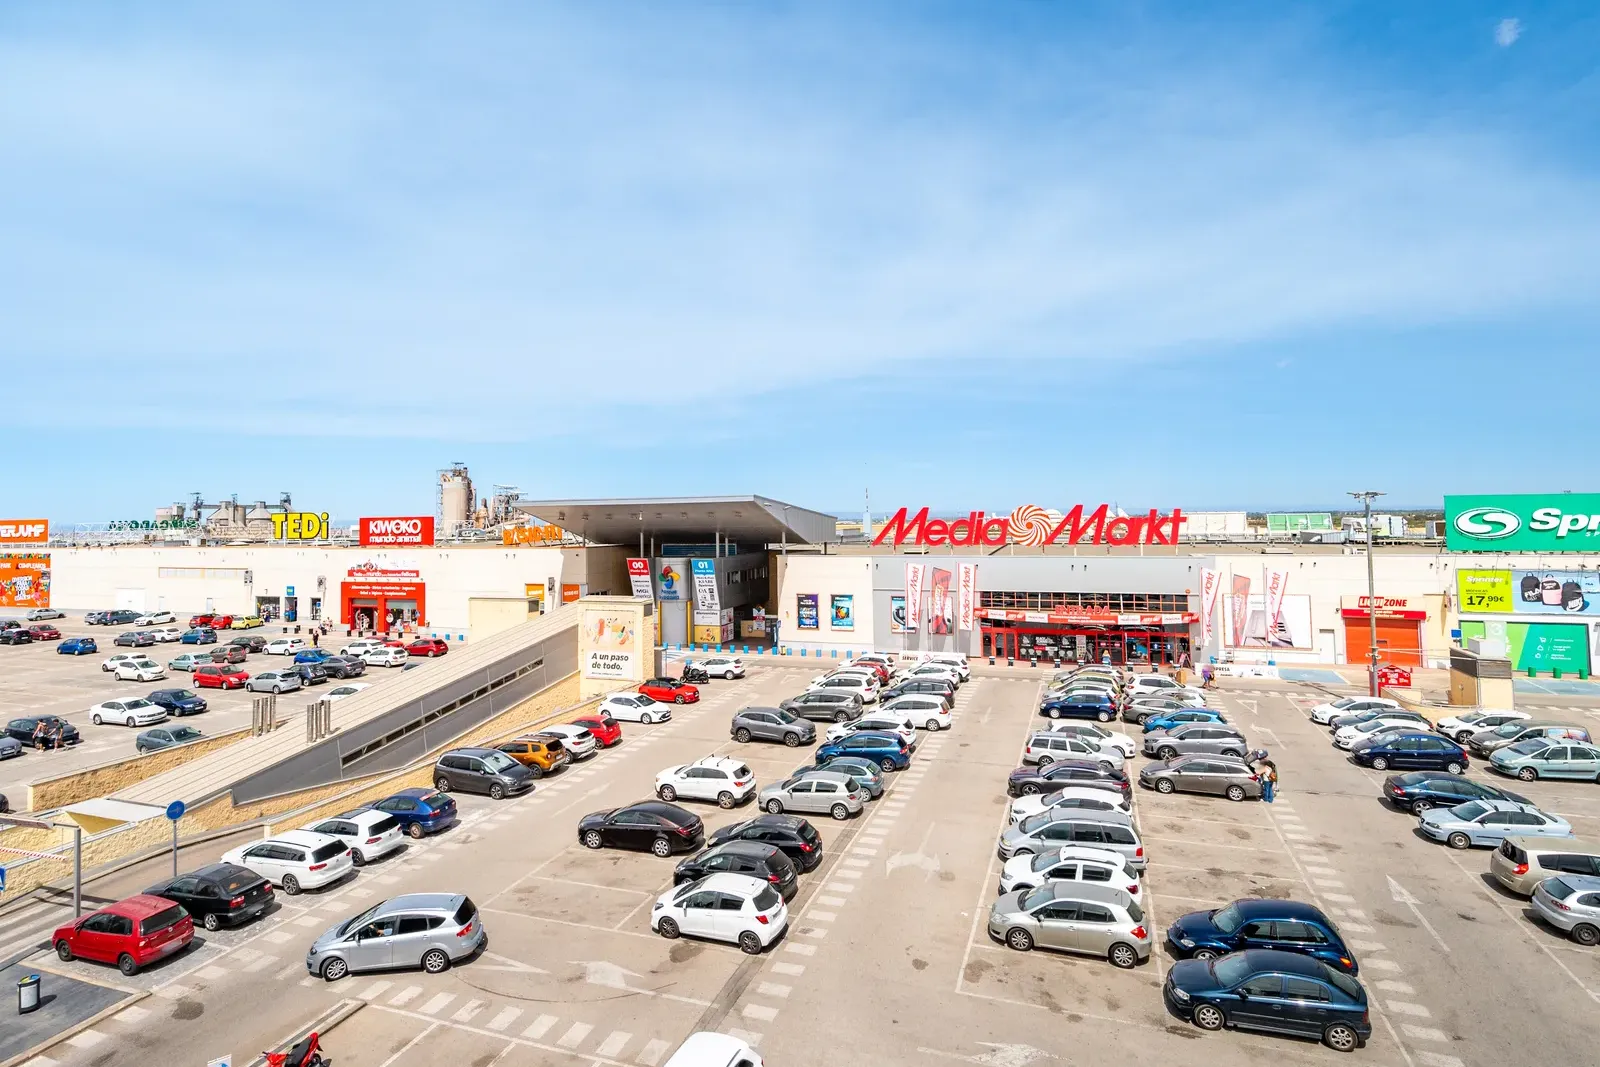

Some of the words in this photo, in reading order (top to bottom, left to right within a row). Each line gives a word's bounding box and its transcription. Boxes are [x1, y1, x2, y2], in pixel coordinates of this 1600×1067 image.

[271, 512, 329, 539] TEDi
[369, 519, 422, 534] KIWOKO
[873, 507, 1009, 547] Media
[1043, 504, 1187, 547] Markt
[370, 534, 396, 543] mundo
[397, 534, 422, 543] animal
[962, 566, 970, 592] Markt
[1466, 575, 1504, 583] Sprinter
[1466, 595, 1505, 608] 17,99€
[1055, 605, 1111, 616] ENTRADA
[591, 652, 597, 660] A
[591, 661, 601, 669] de
[602, 662, 623, 670] todo.
